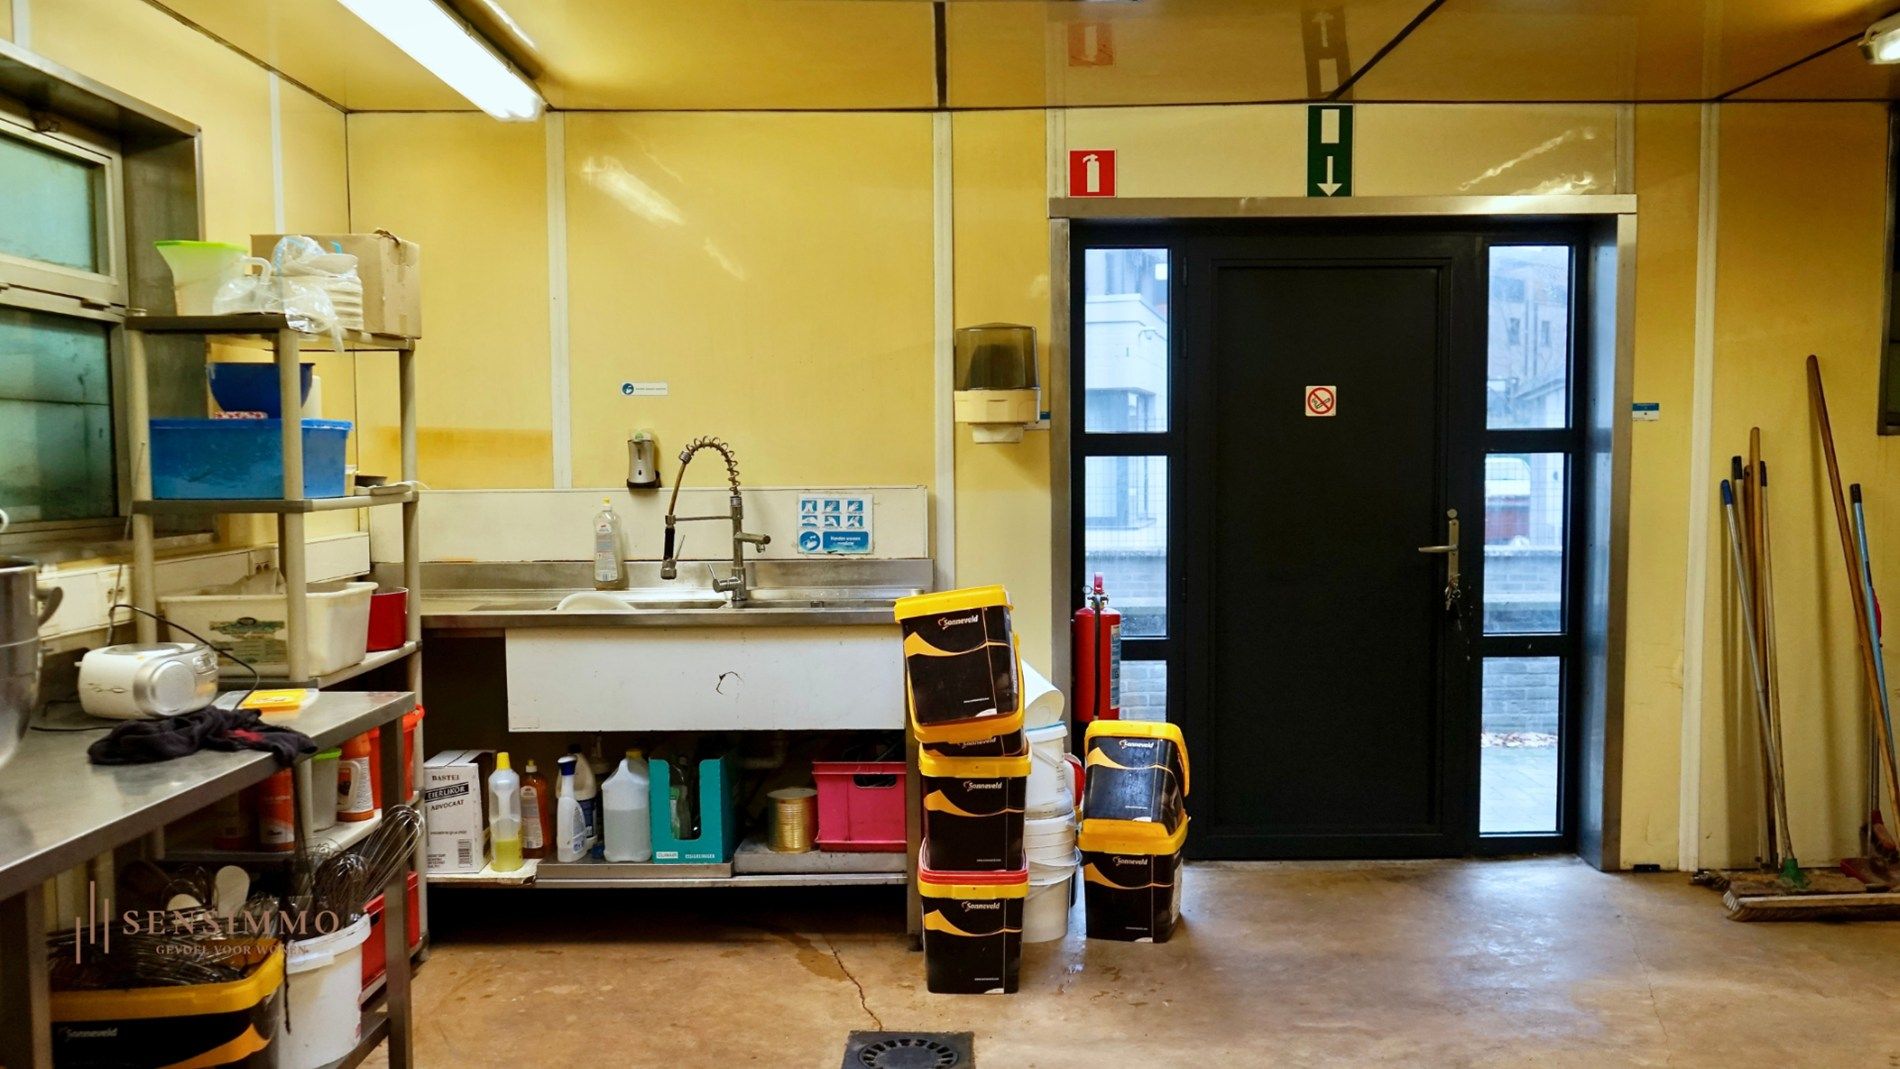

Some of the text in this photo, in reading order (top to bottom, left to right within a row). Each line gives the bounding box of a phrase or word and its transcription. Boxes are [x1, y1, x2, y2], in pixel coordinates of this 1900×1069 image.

[966, 782, 1003, 790] Sonneveld
[430, 799, 465, 811] ADVOCAAT
[1116, 857, 1148, 865] Sonneveld
[964, 902, 1001, 911] Sonneveld
